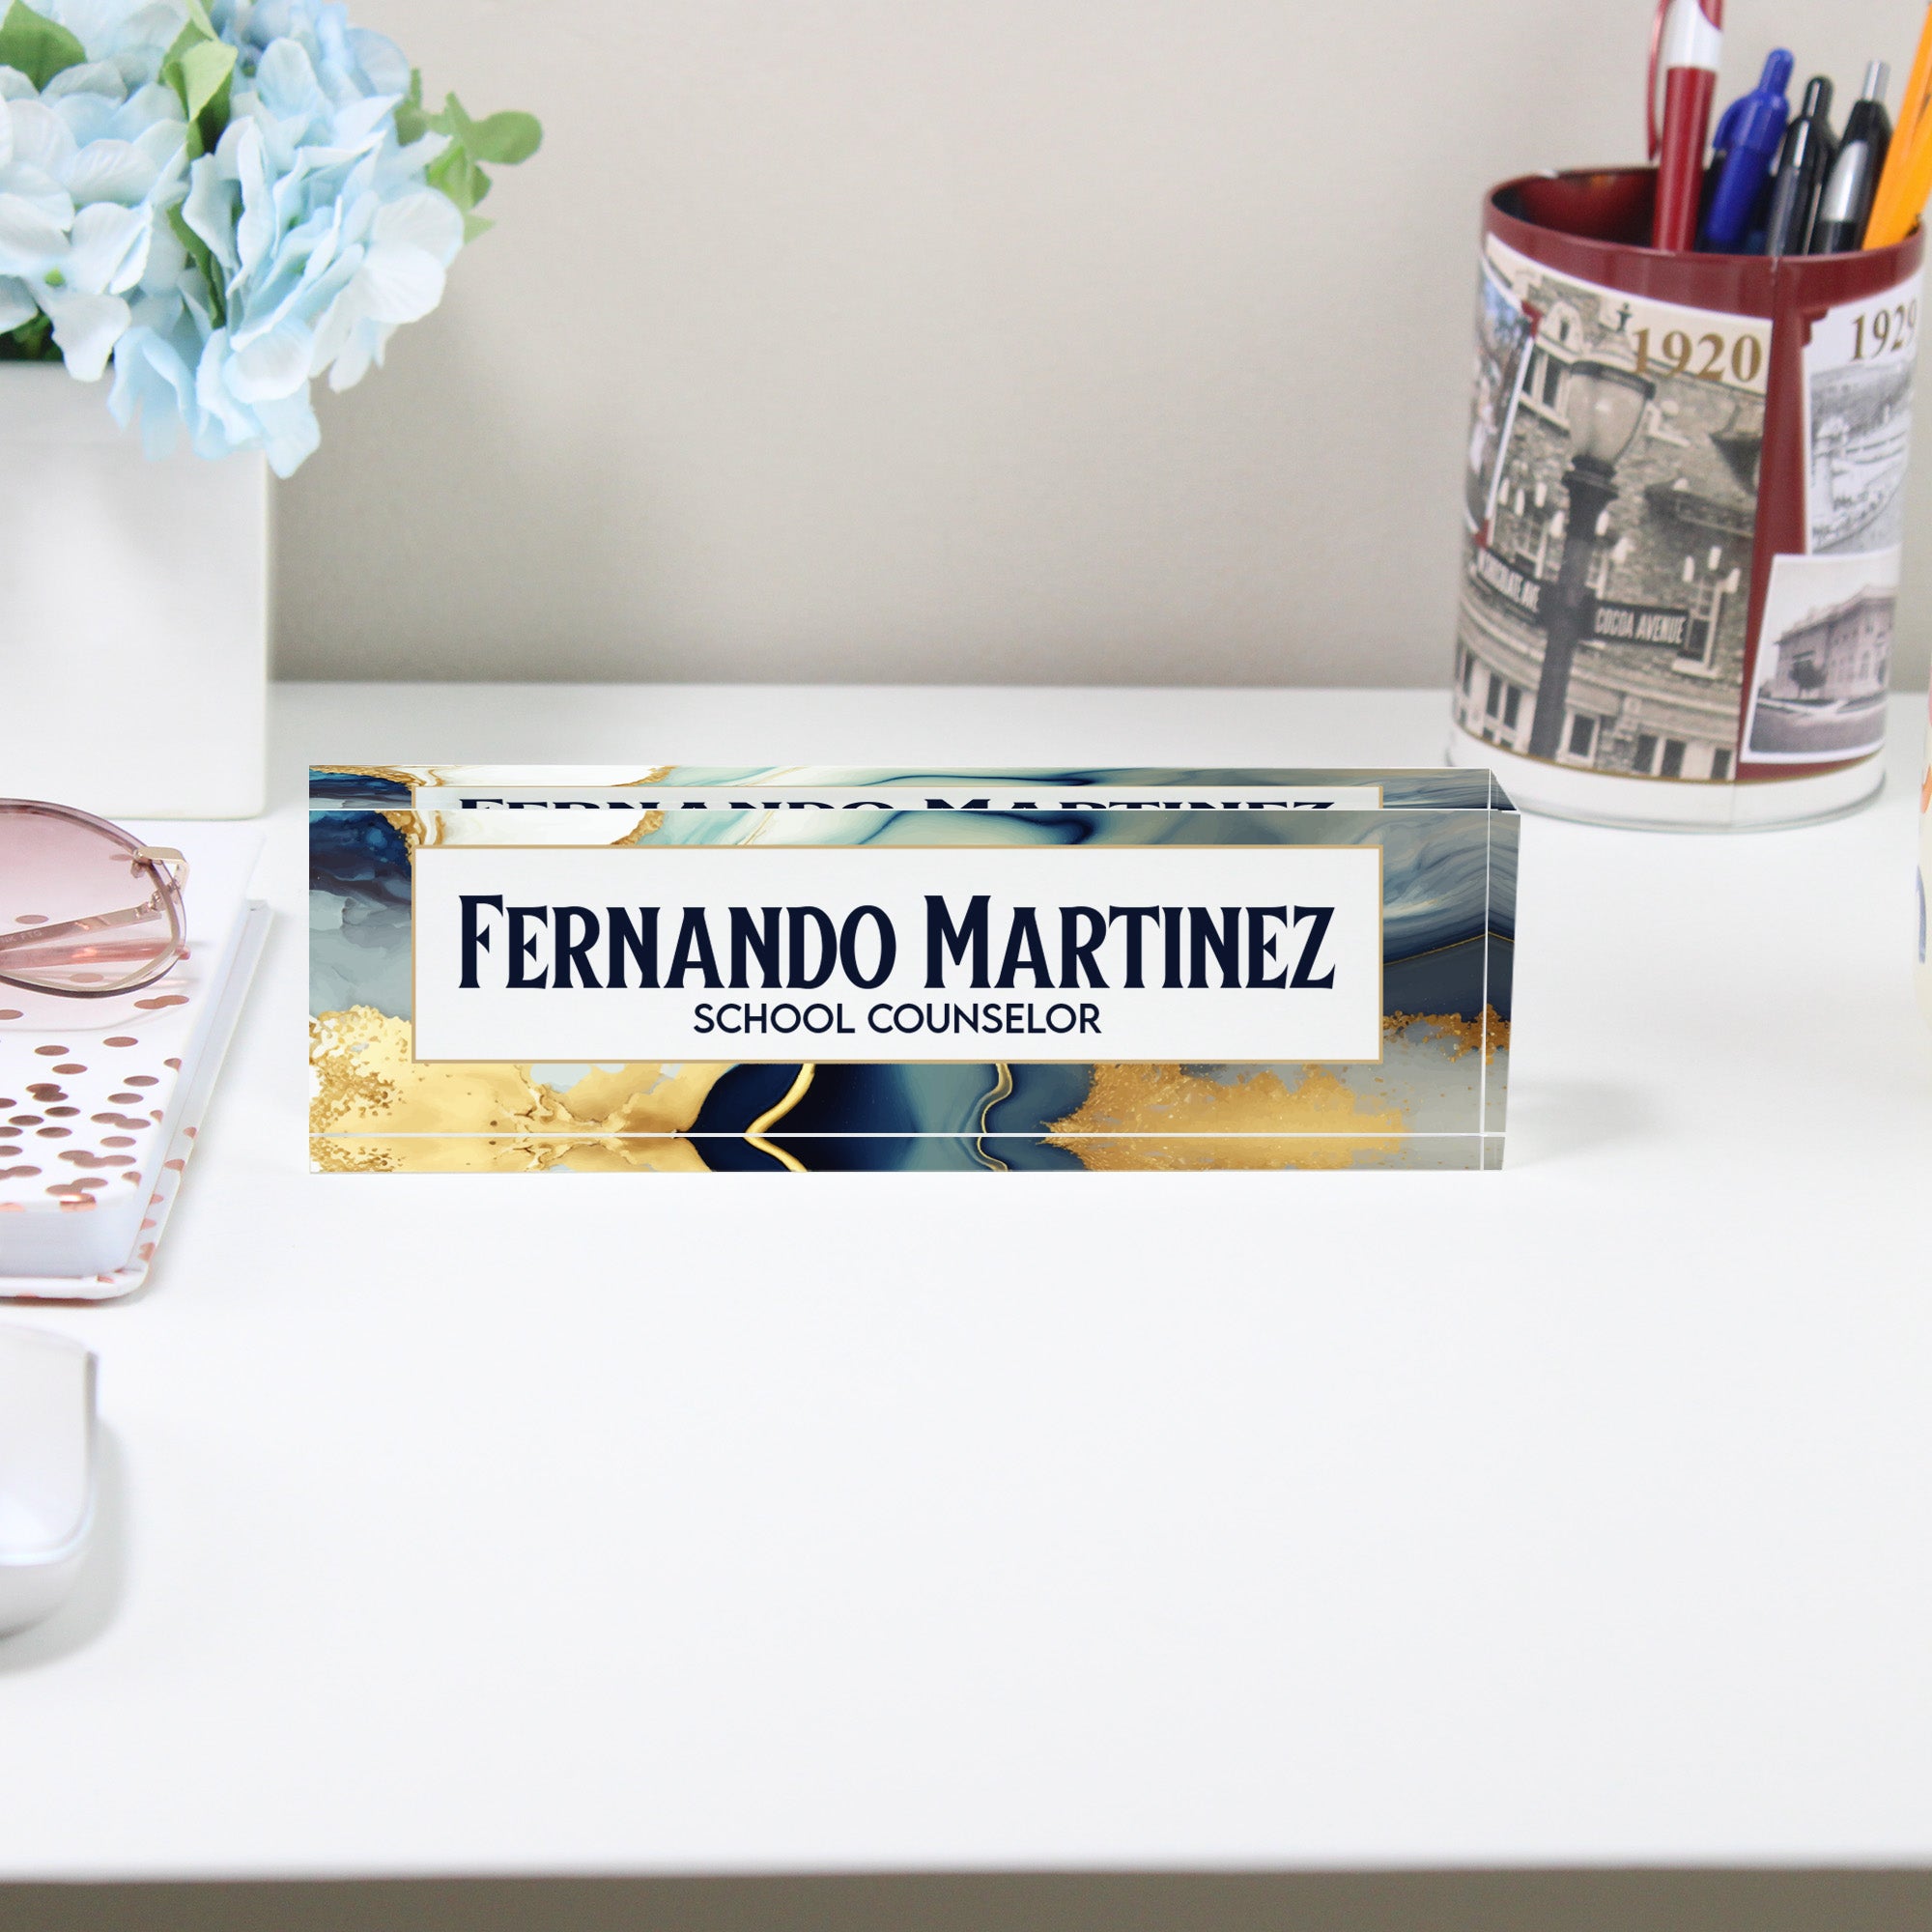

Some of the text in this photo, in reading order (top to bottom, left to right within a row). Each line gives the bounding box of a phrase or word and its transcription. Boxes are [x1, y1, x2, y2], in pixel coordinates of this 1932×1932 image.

[1633, 328, 1762, 383] 1920
[1594, 607, 1687, 645] COCOA AVENUE
[459, 895, 1336, 989] FERNANDO MARTINEZ
[694, 1003, 1102, 1034] SCHOOL COUNSELOR
